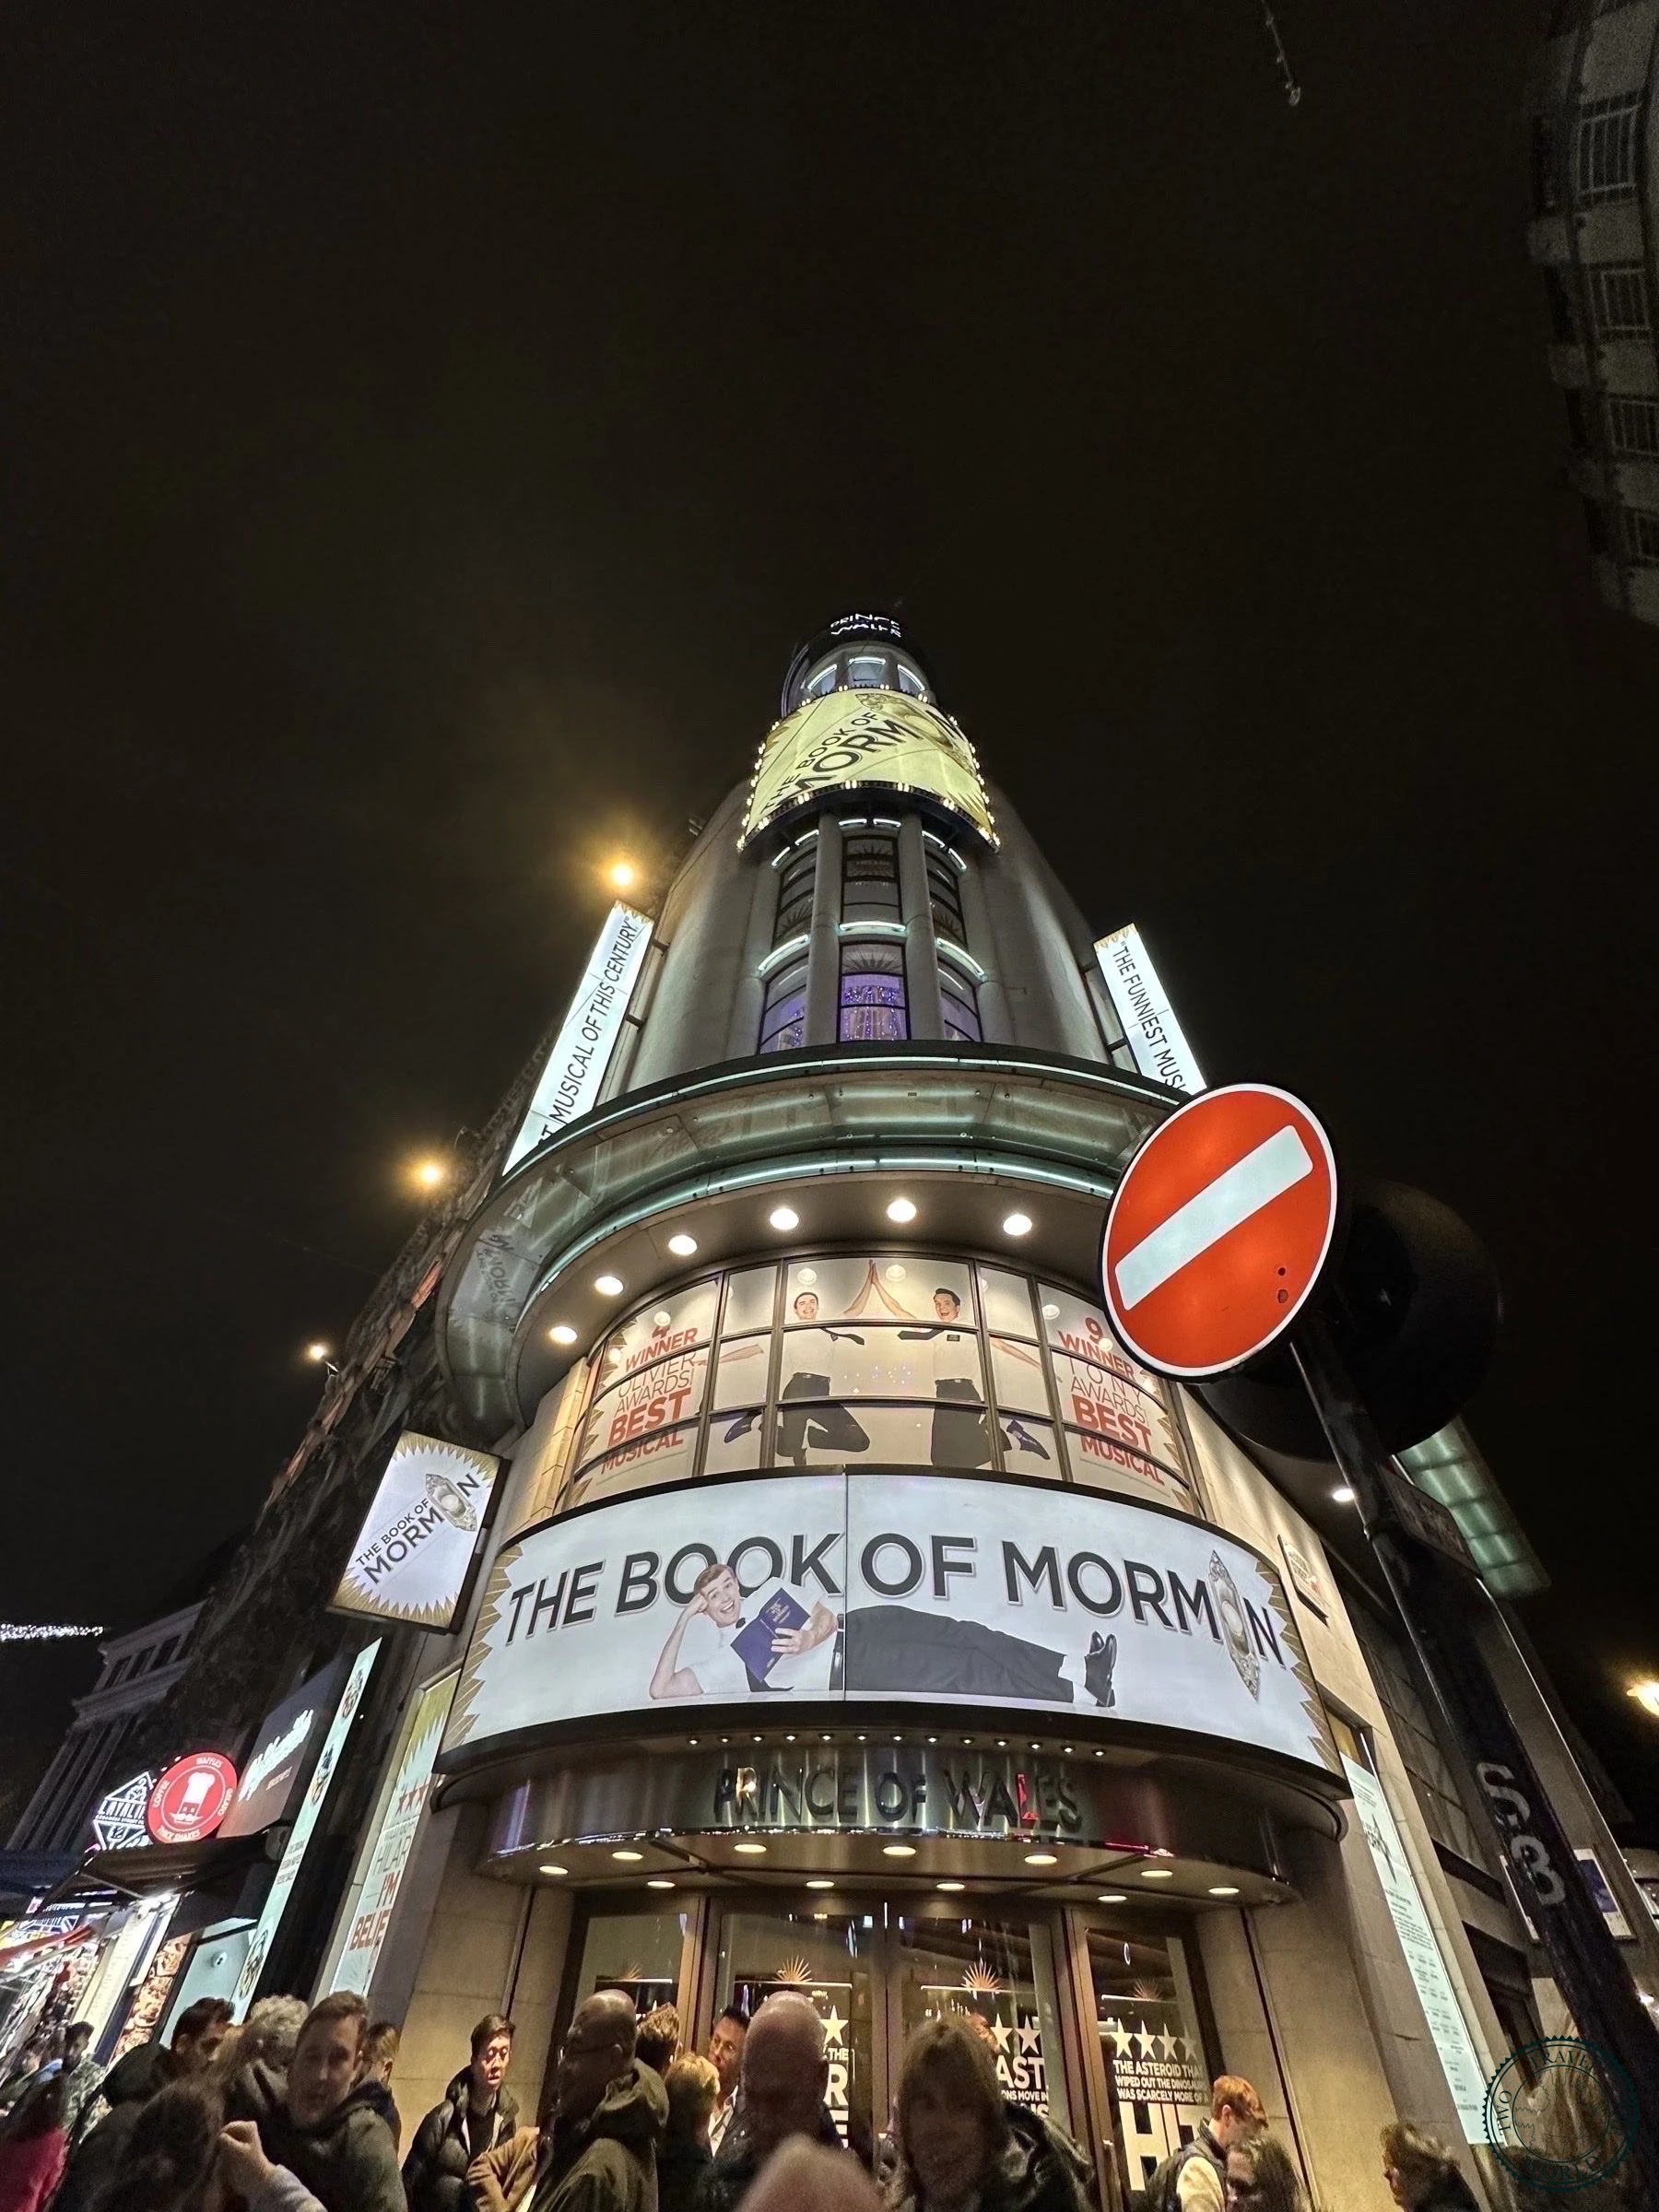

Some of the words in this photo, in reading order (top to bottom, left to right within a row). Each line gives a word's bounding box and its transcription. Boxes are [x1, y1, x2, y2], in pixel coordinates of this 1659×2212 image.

[796, 727, 856, 771] BOOK
[851, 712, 878, 728] OF
[590, 982, 616, 1017] THIS
[1124, 973, 1168, 1047] FUNNIEST
[582, 1015, 603, 1042] OF
[548, 1047, 594, 1125] MUSICAL
[626, 1327, 698, 1372] WINNER
[1085, 1317, 1103, 1342] 9
[618, 1351, 696, 1397] OLIVIER
[1058, 1330, 1135, 1382] WINNER
[614, 1370, 690, 1418] AWARDS
[1071, 1376, 1146, 1424] AWARDS
[607, 1387, 691, 1448] BEST
[1072, 1394, 1151, 1455] BEST
[601, 1430, 683, 1475] MUSICAL
[1080, 1435, 1165, 1486] MUSICAL
[356, 1543, 382, 1566] THE
[382, 1512, 416, 1543] BOOK
[414, 1498, 430, 1514] OF
[505, 1559, 604, 1646] THE
[614, 1532, 845, 1617] BOOK
[860, 1533, 976, 1600] OF
[195, 1757, 223, 1769] WAFFLES
[153, 1780, 171, 1808] COFFEE
[218, 1788, 233, 1817] GELATO
[713, 1766, 860, 1824] PRINCE
[876, 1771, 926, 1822] OF
[943, 1769, 1083, 1833] WALES
[829, 2048, 849, 2061] THE
[1112, 2060, 1135, 2075] THE
[1135, 2061, 1181, 2077] ASTEROID
[1018, 2090, 1041, 2100] MOVE
[1114, 2075, 1140, 2088] WIPED
[1140, 2077, 1157, 2088] OUT
[1157, 2077, 1171, 2089] THE
[1117, 2088, 1136, 2100] WAS
[1135, 2088, 1173, 2101] SCARCELY
[1173, 2090, 1194, 2101] MORE
